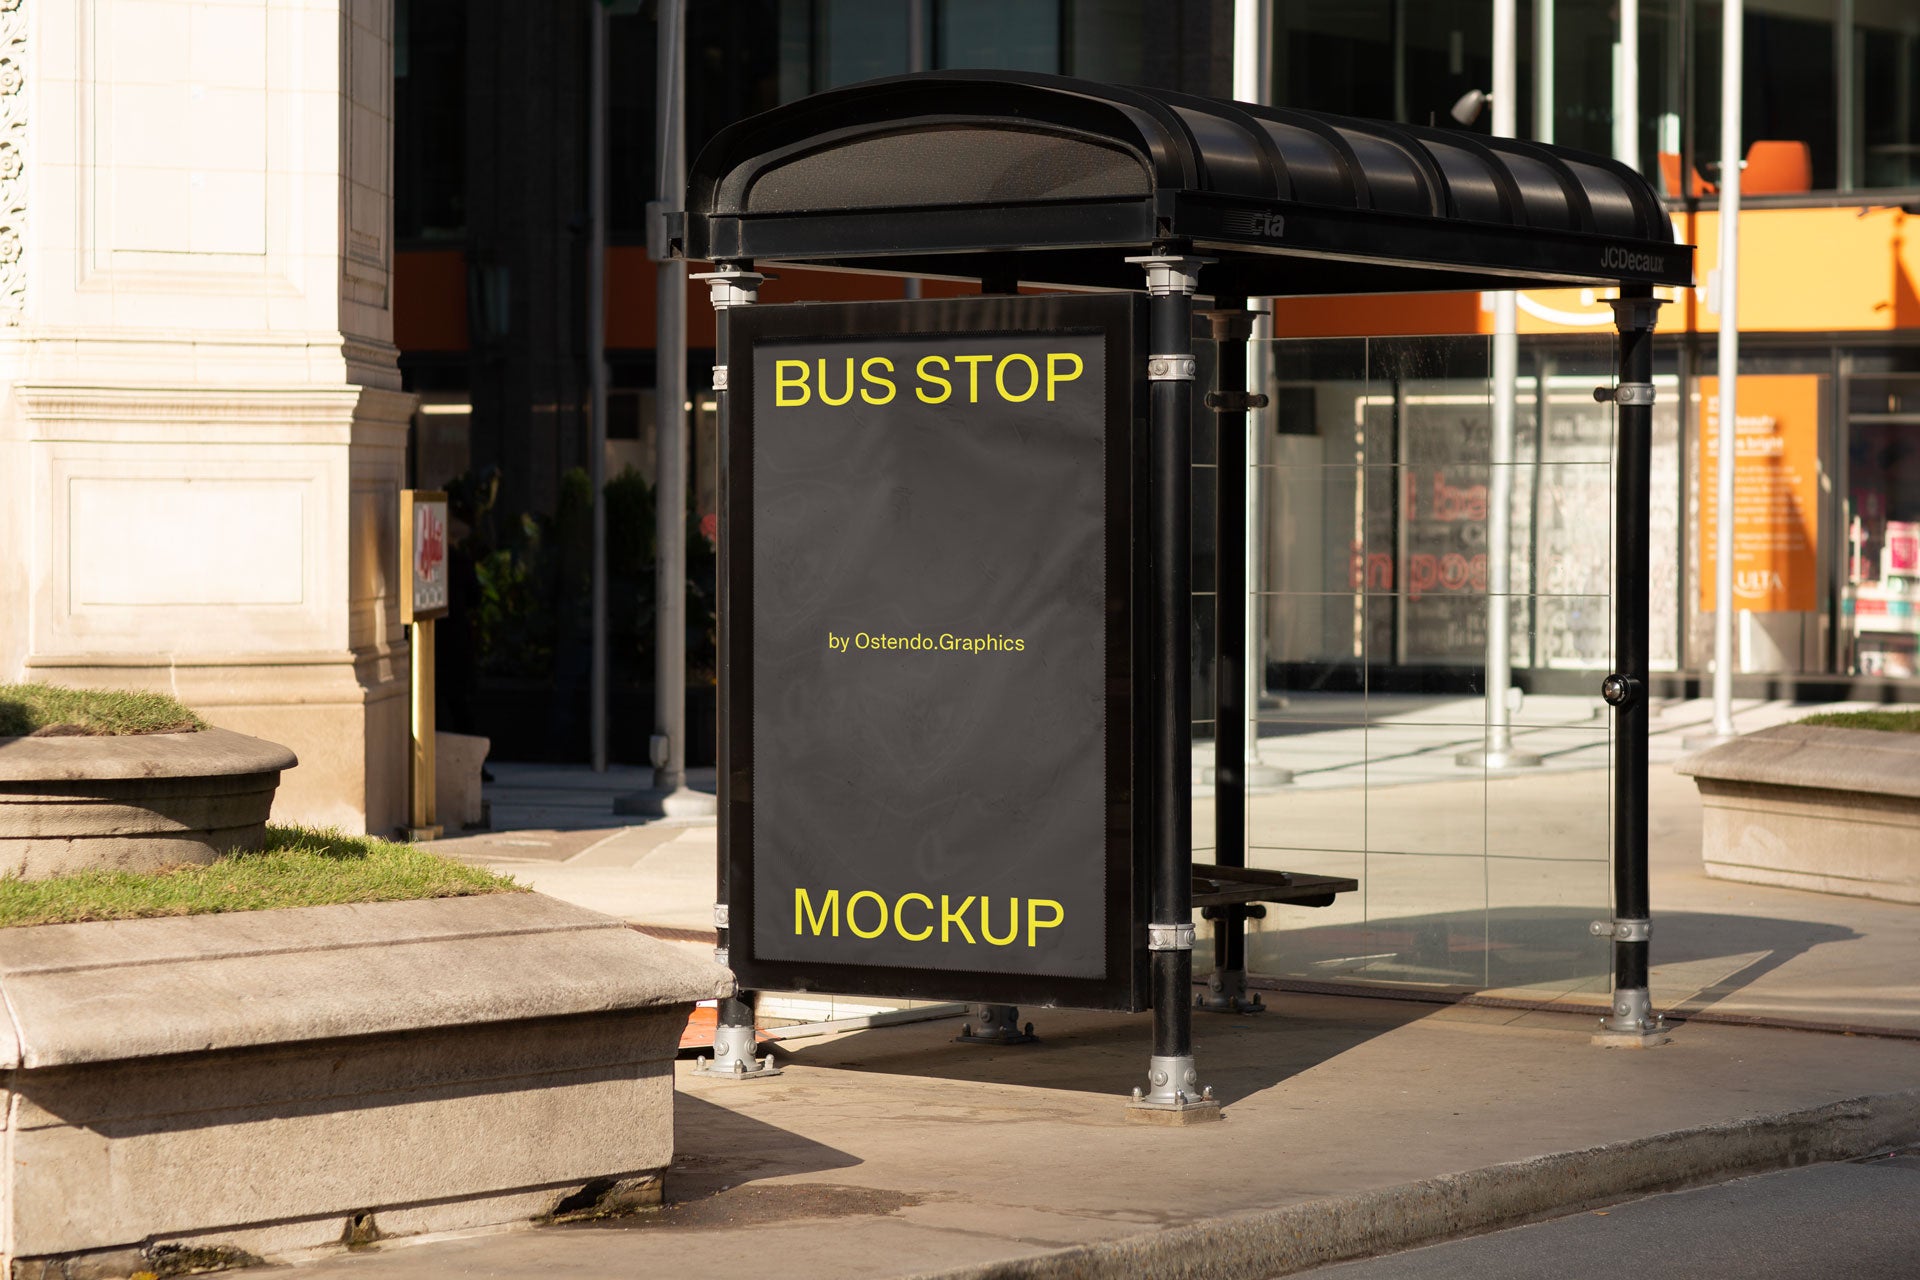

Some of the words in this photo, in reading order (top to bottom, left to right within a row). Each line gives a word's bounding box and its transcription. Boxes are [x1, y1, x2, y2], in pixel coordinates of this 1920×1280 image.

[1600, 246, 1665, 272] JCDecaux
[775, 356, 897, 407] BUS
[915, 352, 1085, 405] STOP
[1737, 570, 1785, 592] ULTA
[828, 631, 850, 653] by
[854, 631, 1025, 655] Ostendo.Graphics
[794, 887, 1065, 948] MOCKUP
